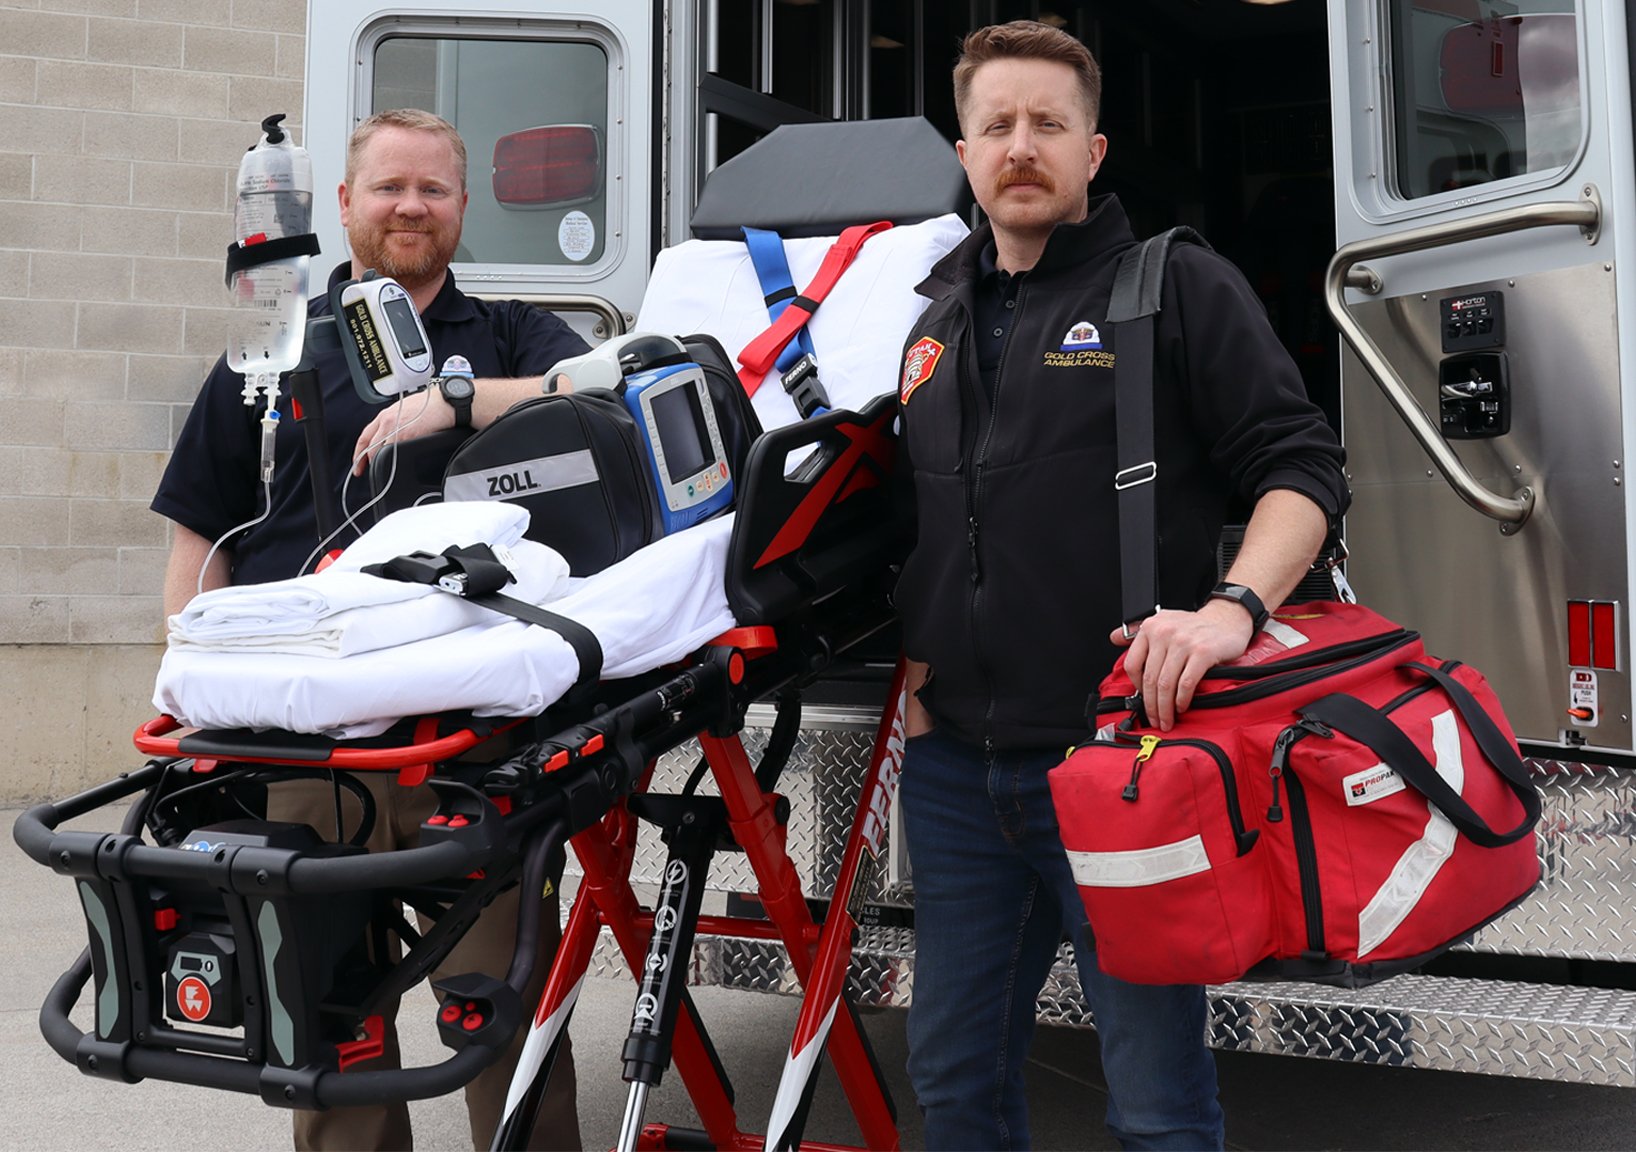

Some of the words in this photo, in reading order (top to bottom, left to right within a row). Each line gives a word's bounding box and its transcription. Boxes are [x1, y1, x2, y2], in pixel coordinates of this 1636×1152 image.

[355, 303, 368, 321] GOLD
[361, 319, 375, 340] CROSS
[1043, 351, 1075, 360] GOLD
[1077, 350, 1116, 361] CROSS
[1043, 358, 1116, 369] AMBULANCE
[784, 360, 807, 385] FERNO
